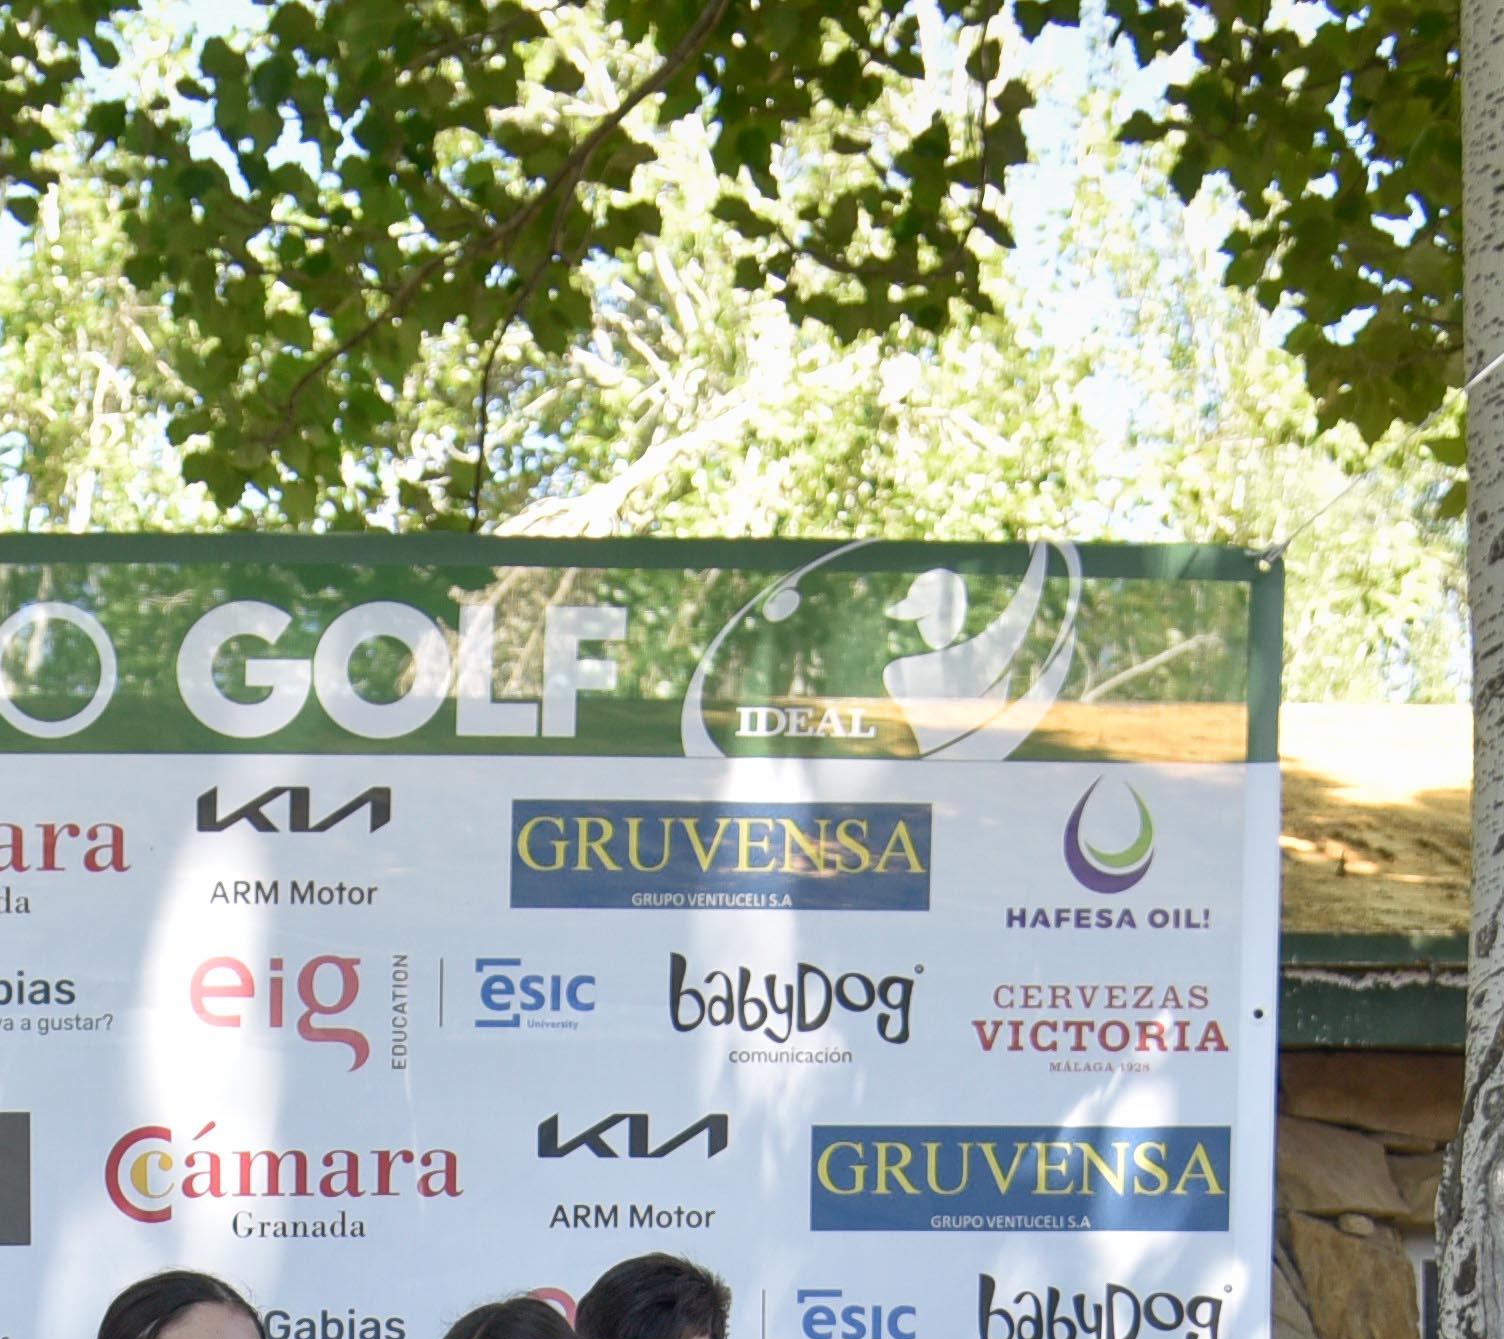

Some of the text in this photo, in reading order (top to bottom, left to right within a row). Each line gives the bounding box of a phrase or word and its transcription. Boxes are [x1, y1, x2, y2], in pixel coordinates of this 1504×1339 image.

[176, 600, 629, 740] GOLF
[735, 705, 876, 739] IDEAL
[516, 816, 926, 874] GRUVENSA
[210, 880, 378, 907] ARM Motor
[630, 892, 684, 908] GRUPO
[686, 892, 766, 908] VENTUCELI
[1006, 907, 1211, 930] HAFESA OIL!
[477, 965, 596, 1014] esic
[992, 984, 1210, 1010] CERVEZAS
[20, 1018, 32, 1032] a
[37, 1012, 113, 1037] gustar?
[190, 955, 370, 1073] eig
[392, 953, 409, 1071] EDUCATION
[526, 1018, 579, 1032] University
[972, 1020, 1229, 1054] VICTORIA
[728, 1045, 852, 1064] comunicación
[1048, 1058, 1151, 1073] MÁLAGA 1928
[816, 1140, 1224, 1197] GRUVENSA
[231, 1209, 367, 1240] Granada
[549, 1204, 716, 1230] ARM Motor
[929, 1214, 983, 1230] GRUPO
[985, 1214, 1066, 1230] VENTUCELI
